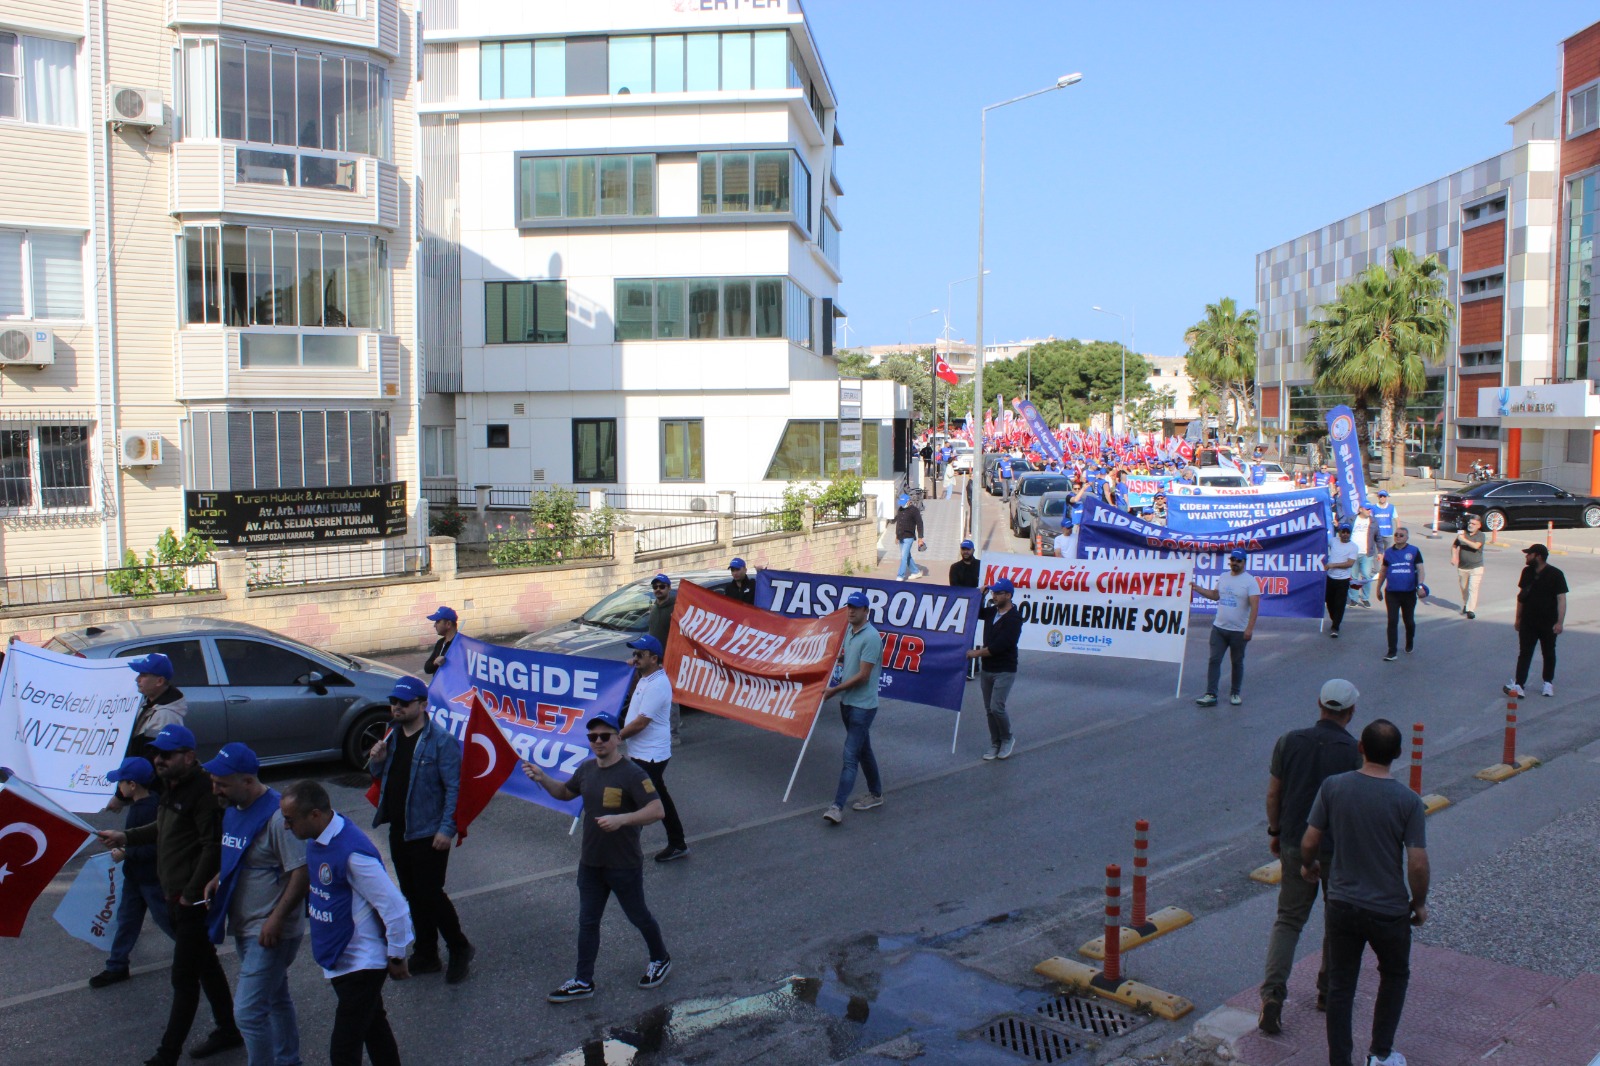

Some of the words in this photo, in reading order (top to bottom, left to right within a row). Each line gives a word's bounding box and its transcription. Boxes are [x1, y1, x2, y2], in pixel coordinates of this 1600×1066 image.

[234, 494, 268, 505] Turan
[270, 492, 303, 503] Hukuk
[305, 491, 313, 501] &
[315, 488, 380, 500] Arabuluculuk
[1180, 503, 1209, 511] KIDEM
[259, 507, 275, 517] Av.
[276, 505, 296, 516] Arb.
[297, 504, 329, 515] HAKAN
[331, 502, 361, 514] TURAN
[1093, 505, 1162, 537] KIDEM
[237, 535, 248, 543] Av.
[249, 533, 268, 542] YUSUF
[269, 532, 286, 541] OZAN
[286, 530, 315, 540] KARAKAŞ
[324, 529, 335, 538] Av.
[336, 528, 358, 537] DERYA
[359, 526, 380, 535] KORAL
[245, 521, 262, 532] Av.
[263, 519, 283, 531] Arb.
[284, 517, 313, 530] SELDA
[314, 516, 342, 528] SEREN
[343, 514, 374, 526] TURAN
[984, 564, 1033, 589] KAZA
[1037, 565, 1090, 592] DEĞİL
[1096, 566, 1186, 597] CİNAYET!
[1019, 594, 1138, 631] ÖLÜMLERİNE
[1142, 608, 1185, 636] SON.
[720, 624, 787, 663] YETER
[1064, 634, 1112, 646] petrol-iş
[20, 681, 98, 715] bereketli
[449, 685, 585, 735] ADALET
